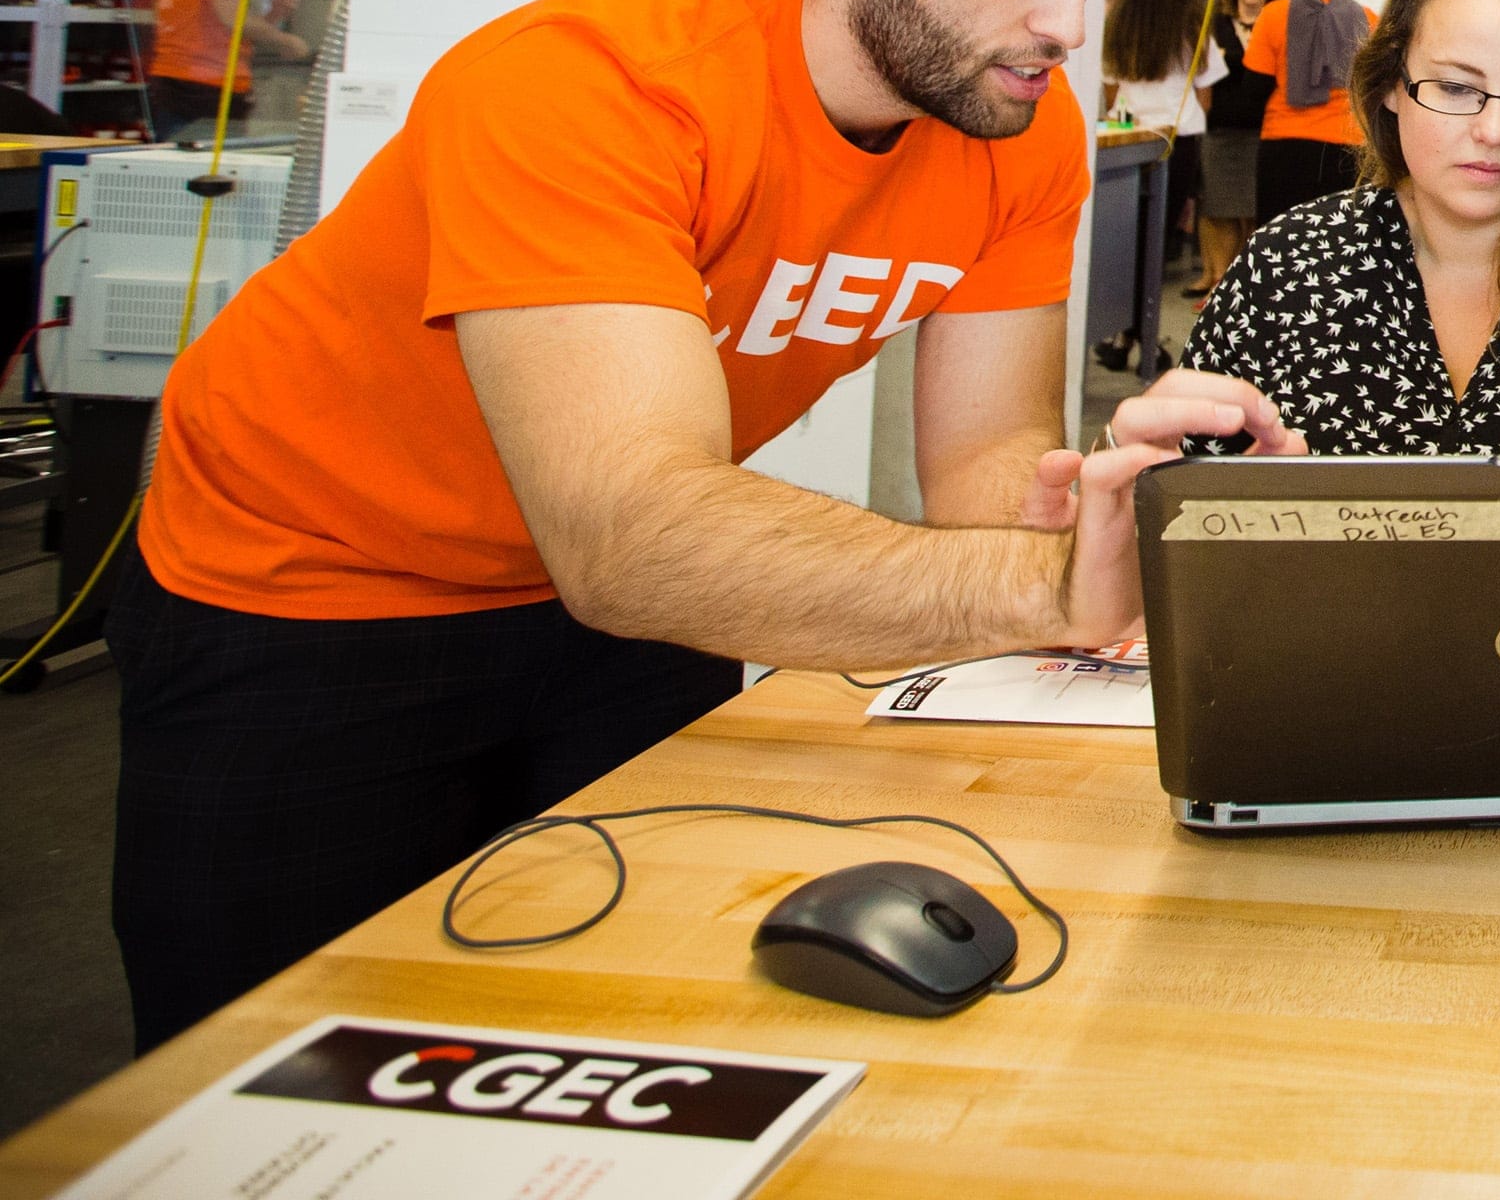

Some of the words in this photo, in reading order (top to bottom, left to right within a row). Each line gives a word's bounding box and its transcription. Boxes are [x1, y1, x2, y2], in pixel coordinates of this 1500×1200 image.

[704, 252, 965, 356] EED
[1338, 506, 1459, 523] Outreach
[366, 1044, 713, 1125] CGEC
